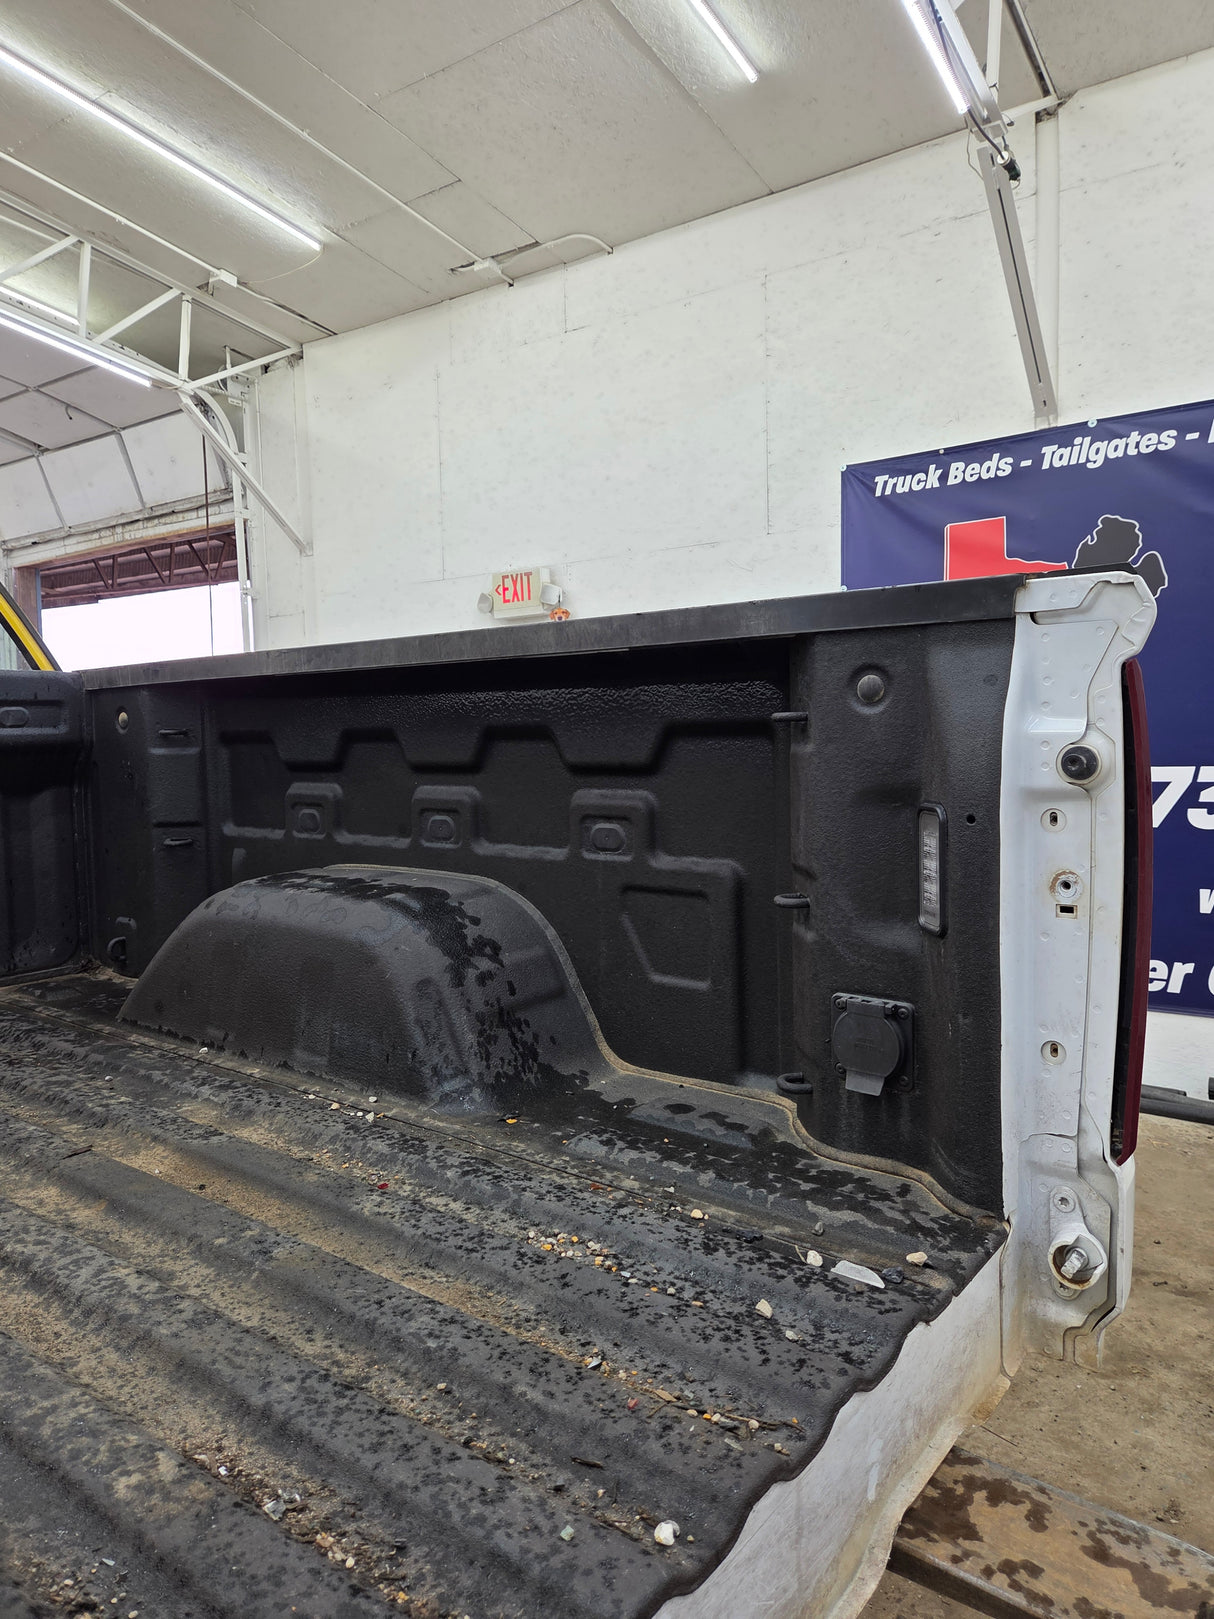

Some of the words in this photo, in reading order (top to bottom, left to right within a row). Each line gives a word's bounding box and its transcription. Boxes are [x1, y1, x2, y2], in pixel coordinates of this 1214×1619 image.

[874, 464, 941, 498] Truck
[947, 453, 1014, 486] Beds
[1040, 429, 1178, 470] Tailgates
[501, 571, 532, 604] EXIT
